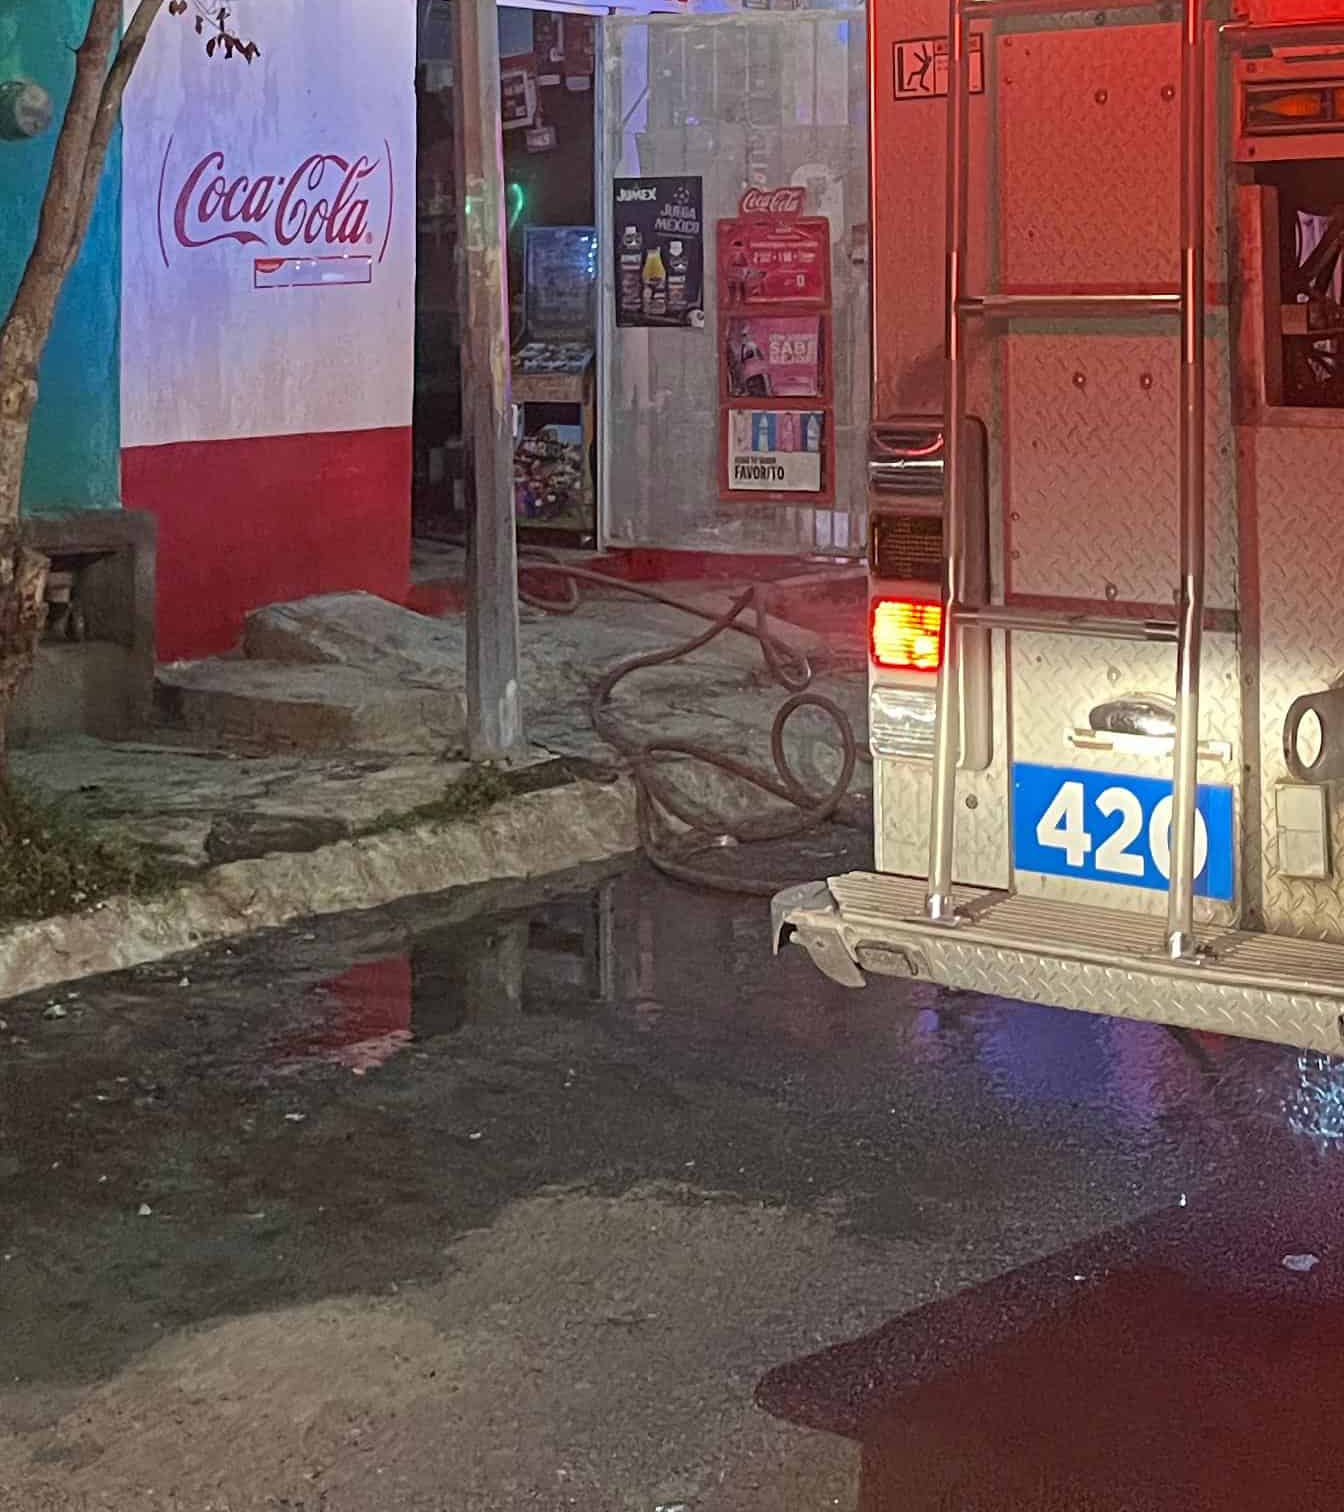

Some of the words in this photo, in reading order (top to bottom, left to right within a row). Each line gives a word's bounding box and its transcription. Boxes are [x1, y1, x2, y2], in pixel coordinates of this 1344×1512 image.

[174, 151, 380, 248] Coca-Cola
[616, 187, 657, 202] JUMEX
[742, 188, 801, 213] Coca-Cola
[734, 465, 785, 481] FAVORITO
[1035, 781, 1208, 881] 420
